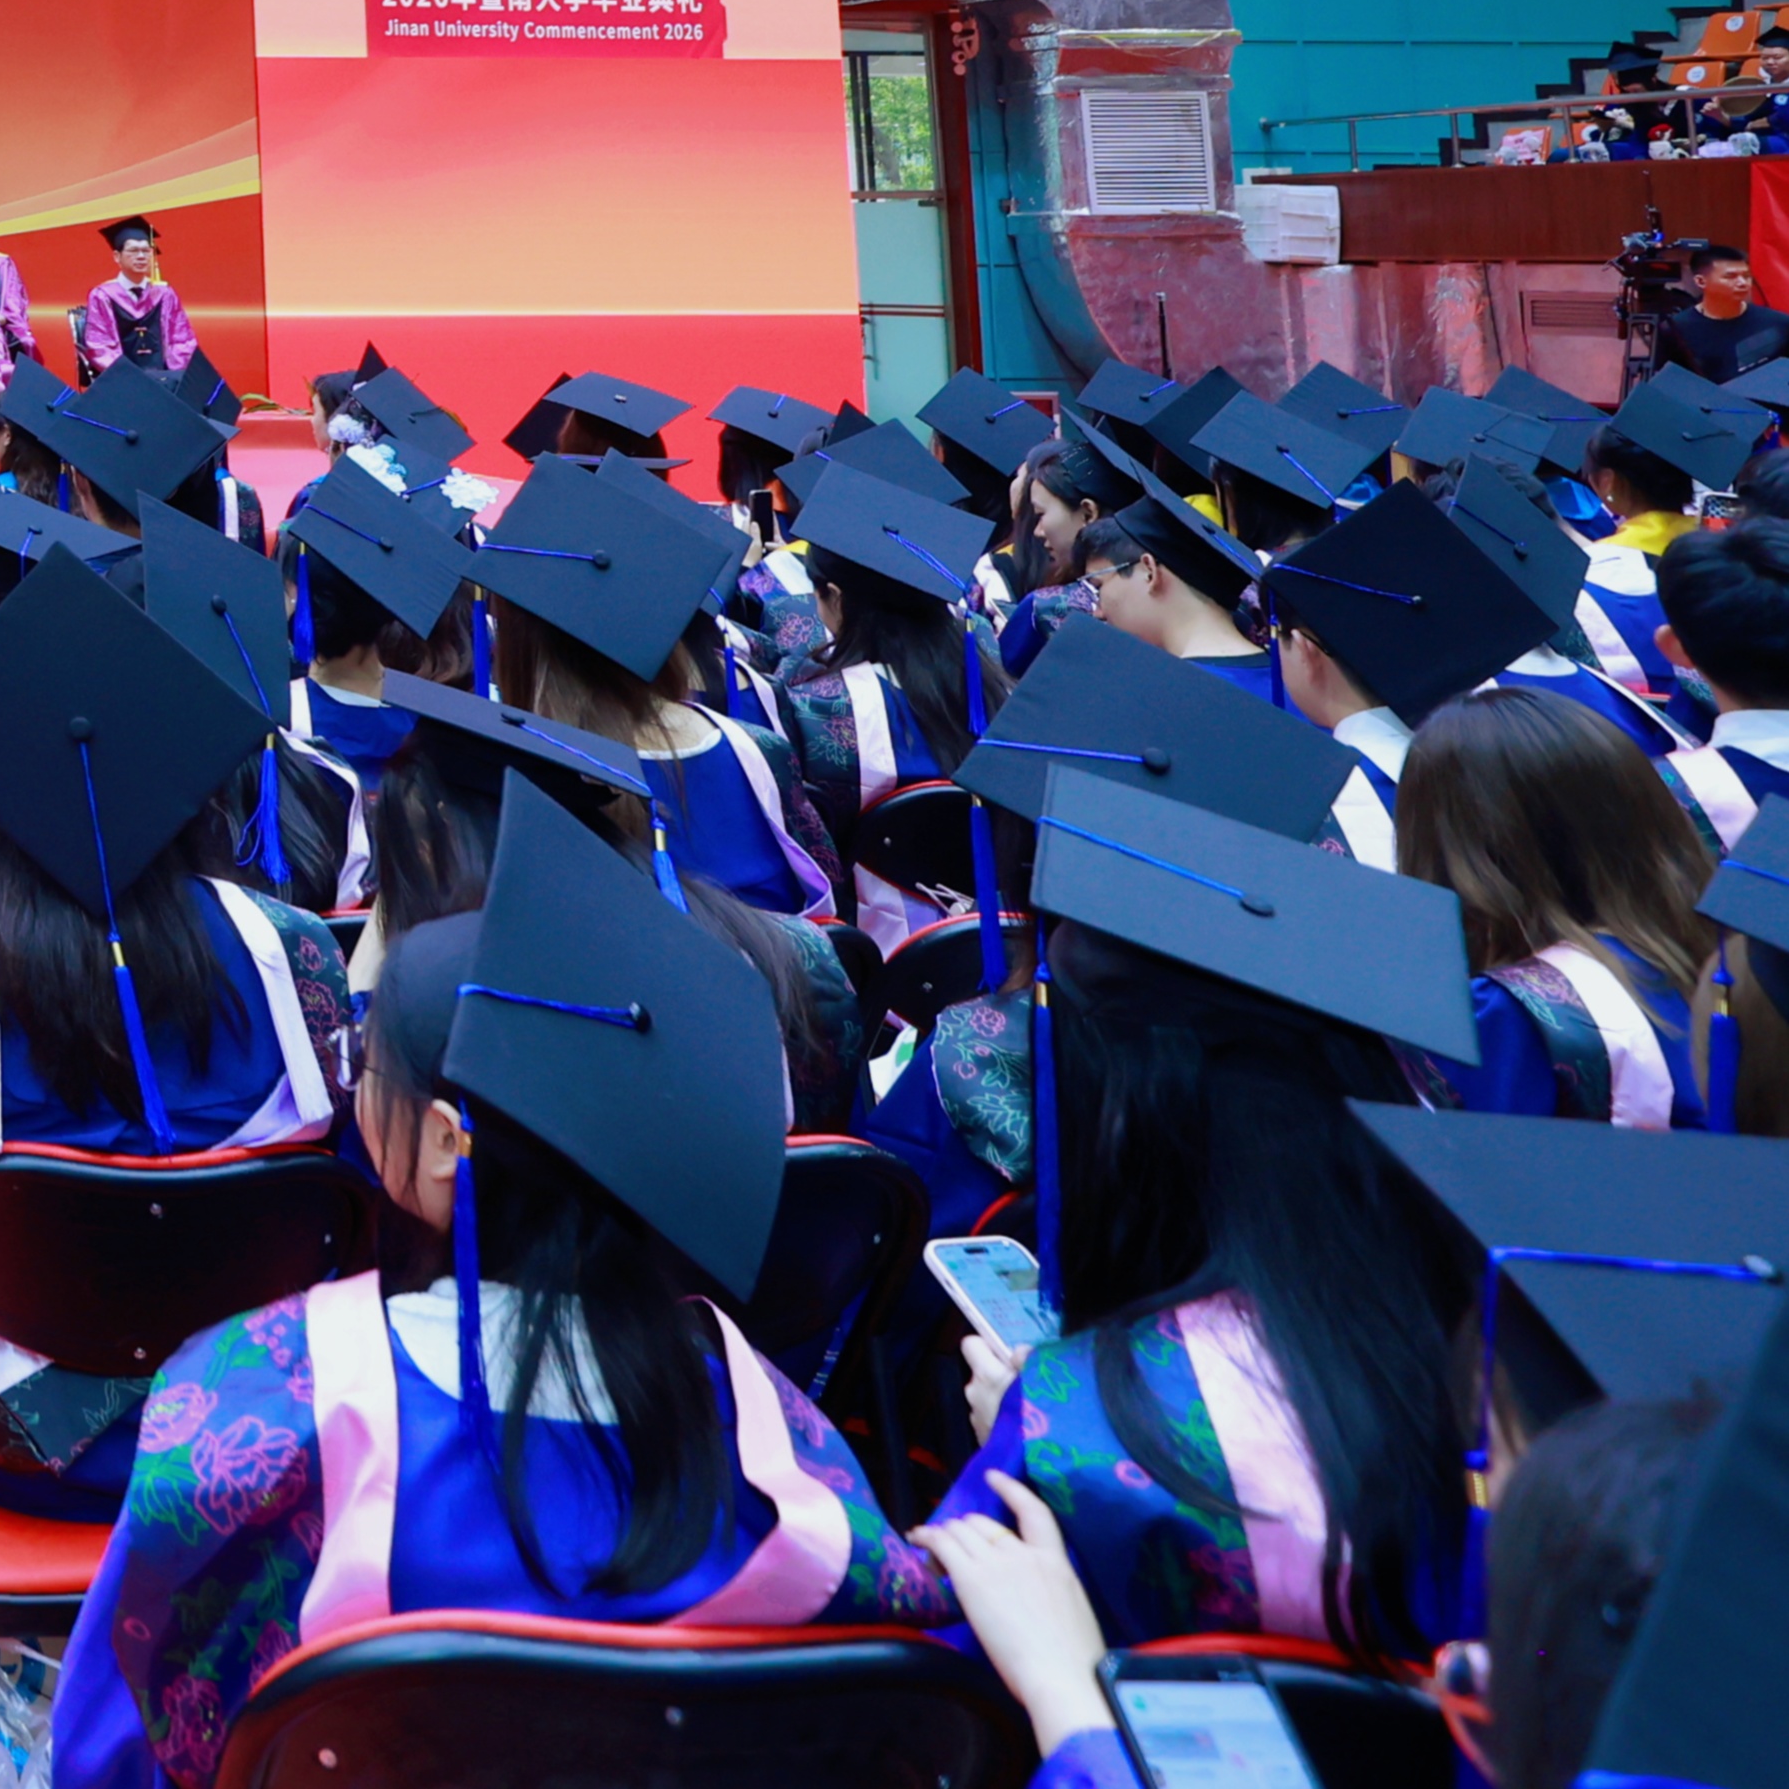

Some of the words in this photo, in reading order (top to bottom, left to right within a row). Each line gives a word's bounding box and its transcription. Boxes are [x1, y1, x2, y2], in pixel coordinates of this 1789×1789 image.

[384, 18, 430, 37] Jinan
[434, 19, 520, 42] University
[523, 21, 660, 40] Commencement
[663, 23, 704, 41] 2026
